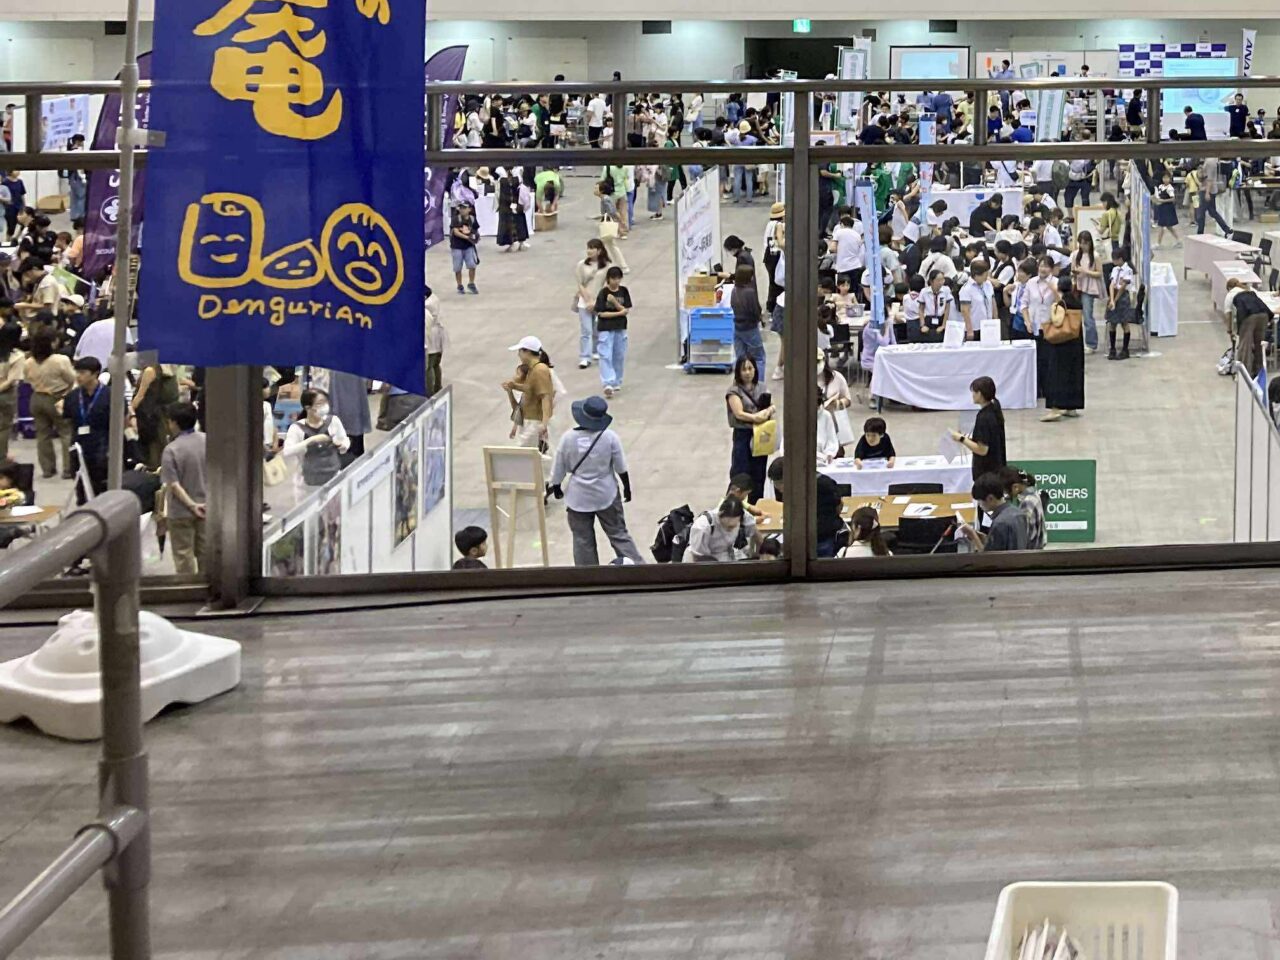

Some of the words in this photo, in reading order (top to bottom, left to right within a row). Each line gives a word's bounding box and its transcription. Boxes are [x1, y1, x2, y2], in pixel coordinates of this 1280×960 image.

[1244, 38, 1253, 71] ANA
[1034, 473, 1067, 485] PPON
[1046, 503, 1073, 514] OOL
